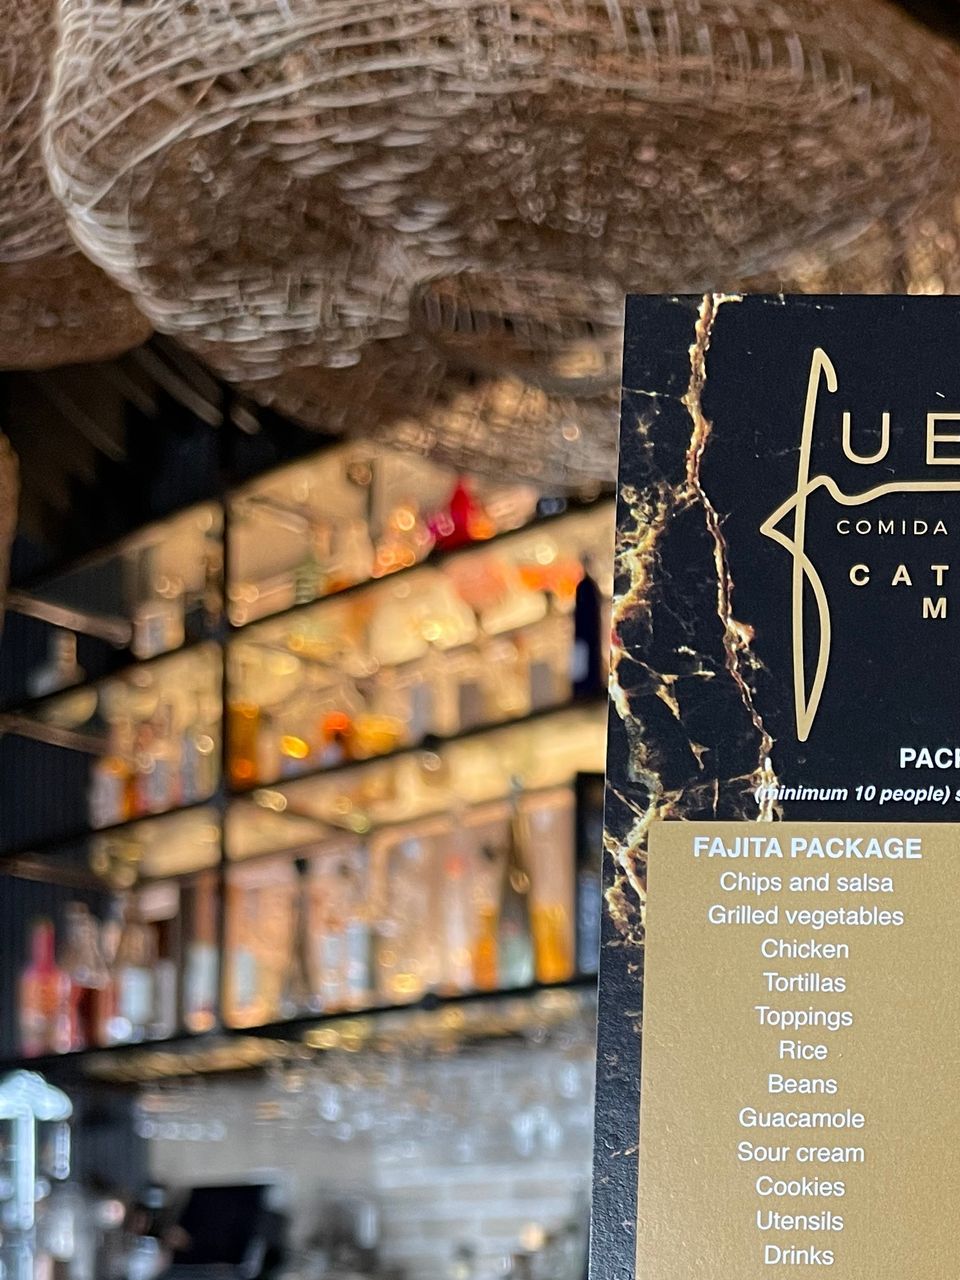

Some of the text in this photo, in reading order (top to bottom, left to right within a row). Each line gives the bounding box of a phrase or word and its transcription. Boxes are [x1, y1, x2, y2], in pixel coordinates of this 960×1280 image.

[836, 520, 950, 536] COMIDA
[855, 785, 874, 802] 10
[878, 784, 950, 804] people)
[694, 837, 922, 858] FAJITA PACKAGE
[720, 872, 893, 895] Chips and salsa
[709, 905, 903, 929] Grilled vegetables
[762, 939, 848, 958] Chicken
[763, 973, 846, 992] Tortillas
[755, 1006, 852, 1030] Toppings
[780, 1040, 827, 1059] Rice
[769, 1074, 837, 1093] Beans
[739, 1107, 864, 1128] Guacamole
[738, 1142, 864, 1162] Sour cream
[756, 1176, 844, 1196] Cookies
[757, 1210, 843, 1230] Utensils
[765, 1245, 833, 1265] Drinks
